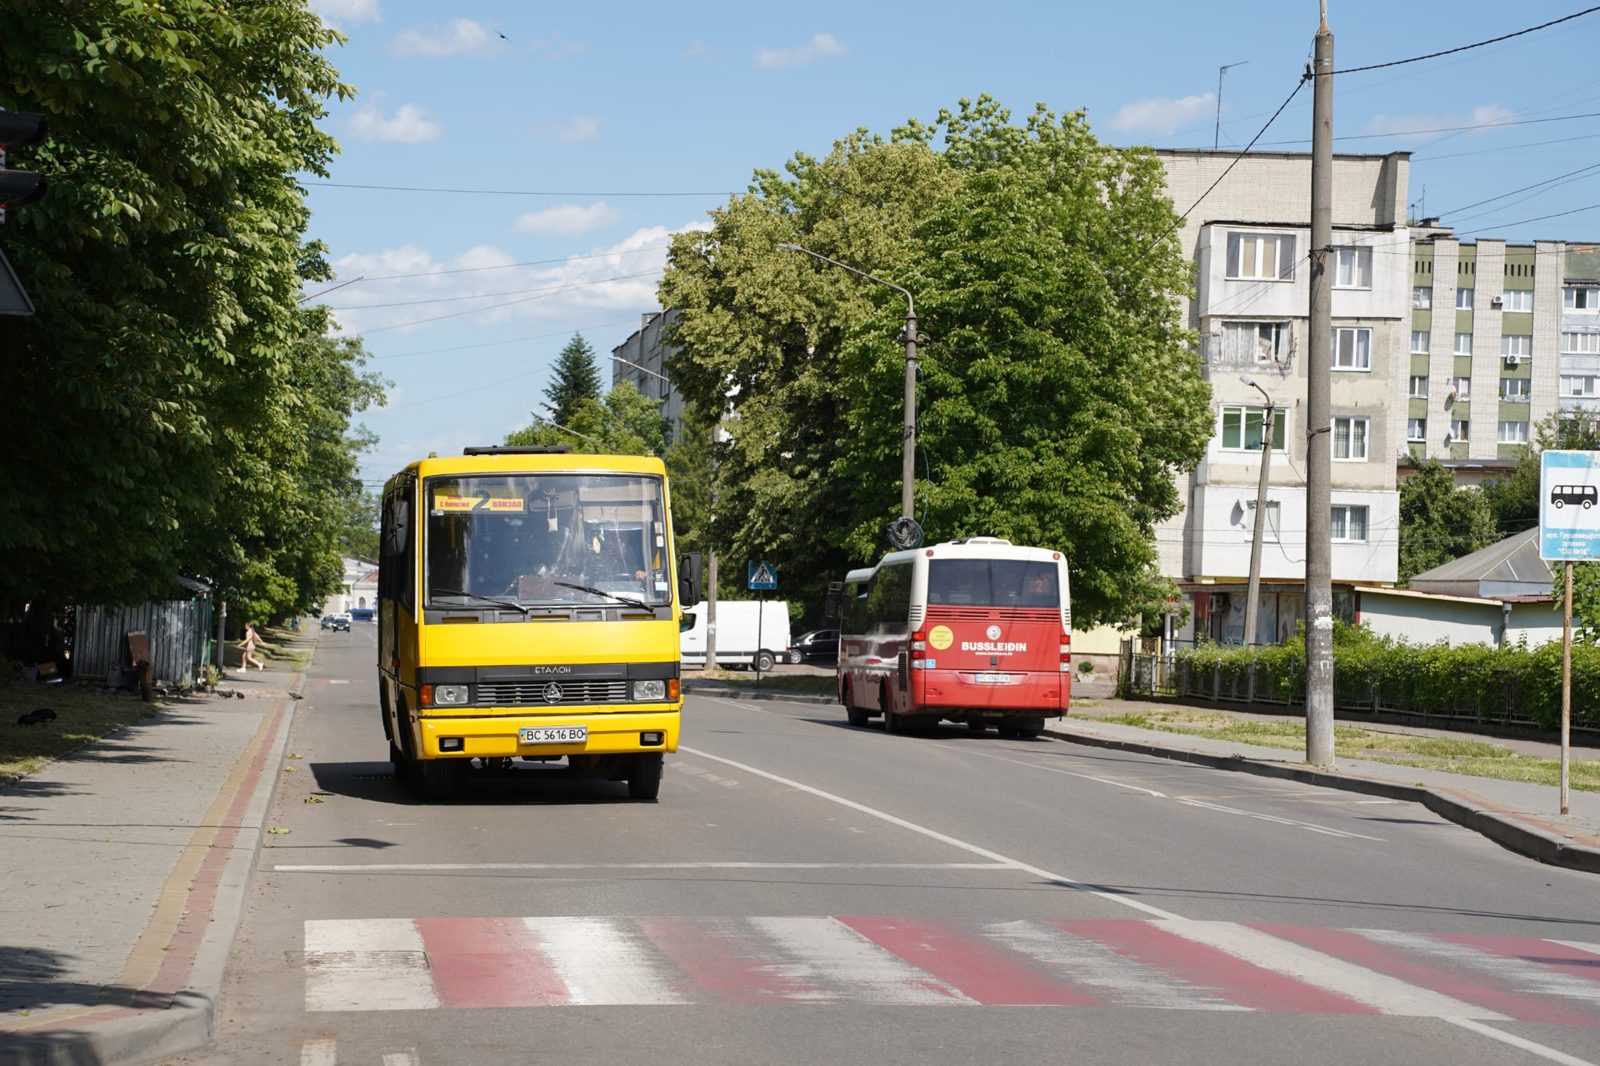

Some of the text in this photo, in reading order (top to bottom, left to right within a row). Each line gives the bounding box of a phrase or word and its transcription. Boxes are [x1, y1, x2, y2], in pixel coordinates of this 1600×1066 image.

[472, 489, 491, 511] 2
[526, 729, 584, 741] BC 5616 BO
